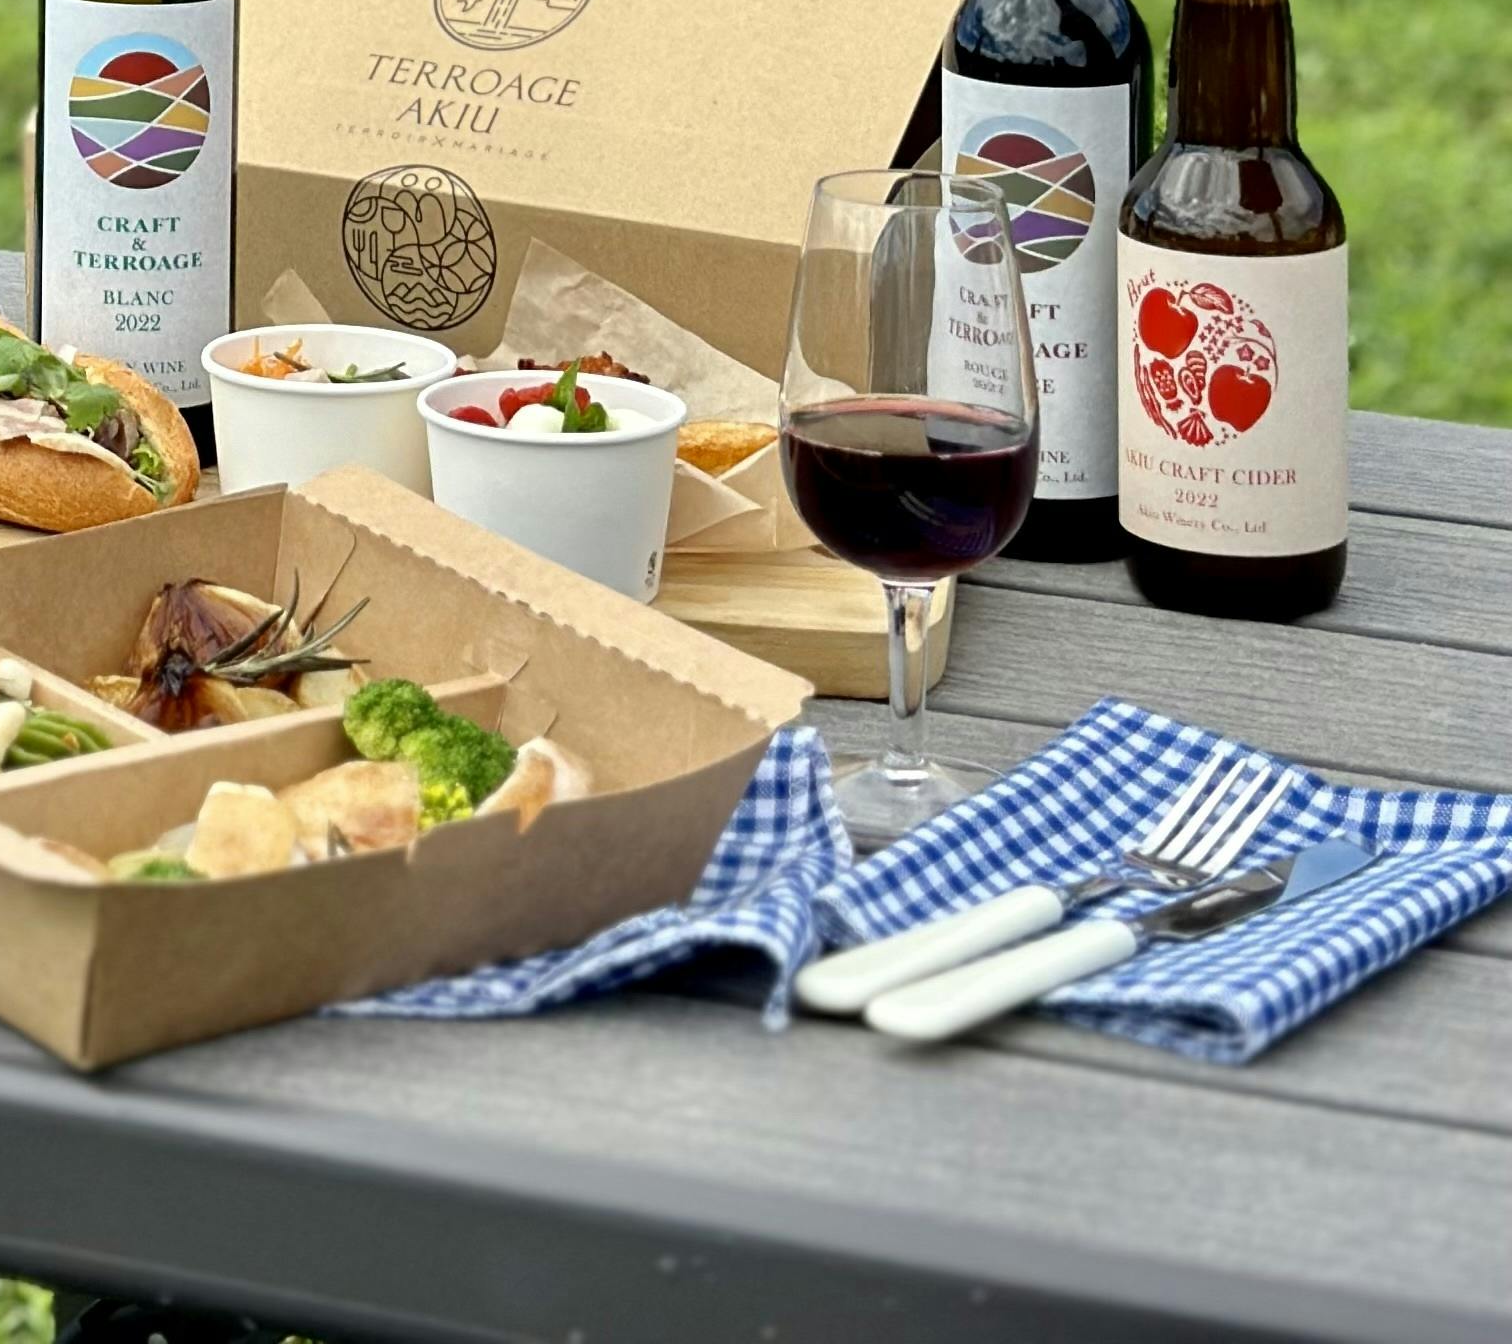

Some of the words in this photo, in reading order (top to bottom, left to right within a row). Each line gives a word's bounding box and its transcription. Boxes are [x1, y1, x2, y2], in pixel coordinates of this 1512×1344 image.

[368, 53, 581, 108] TERROAGE
[396, 97, 500, 135] AKIU
[97, 215, 181, 233] CRAFT
[131, 237, 147, 252] &
[73, 249, 203, 271] TERROAGE
[103, 289, 175, 307] BLANC
[1126, 268, 1157, 309] Brut
[115, 313, 162, 333] 2022
[142, 359, 187, 376] WINE
[1040, 450, 1071, 465] INE
[1159, 459, 1225, 485] CRAFT
[1231, 468, 1297, 486] CIDER
[1174, 488, 1219, 509] 2022
